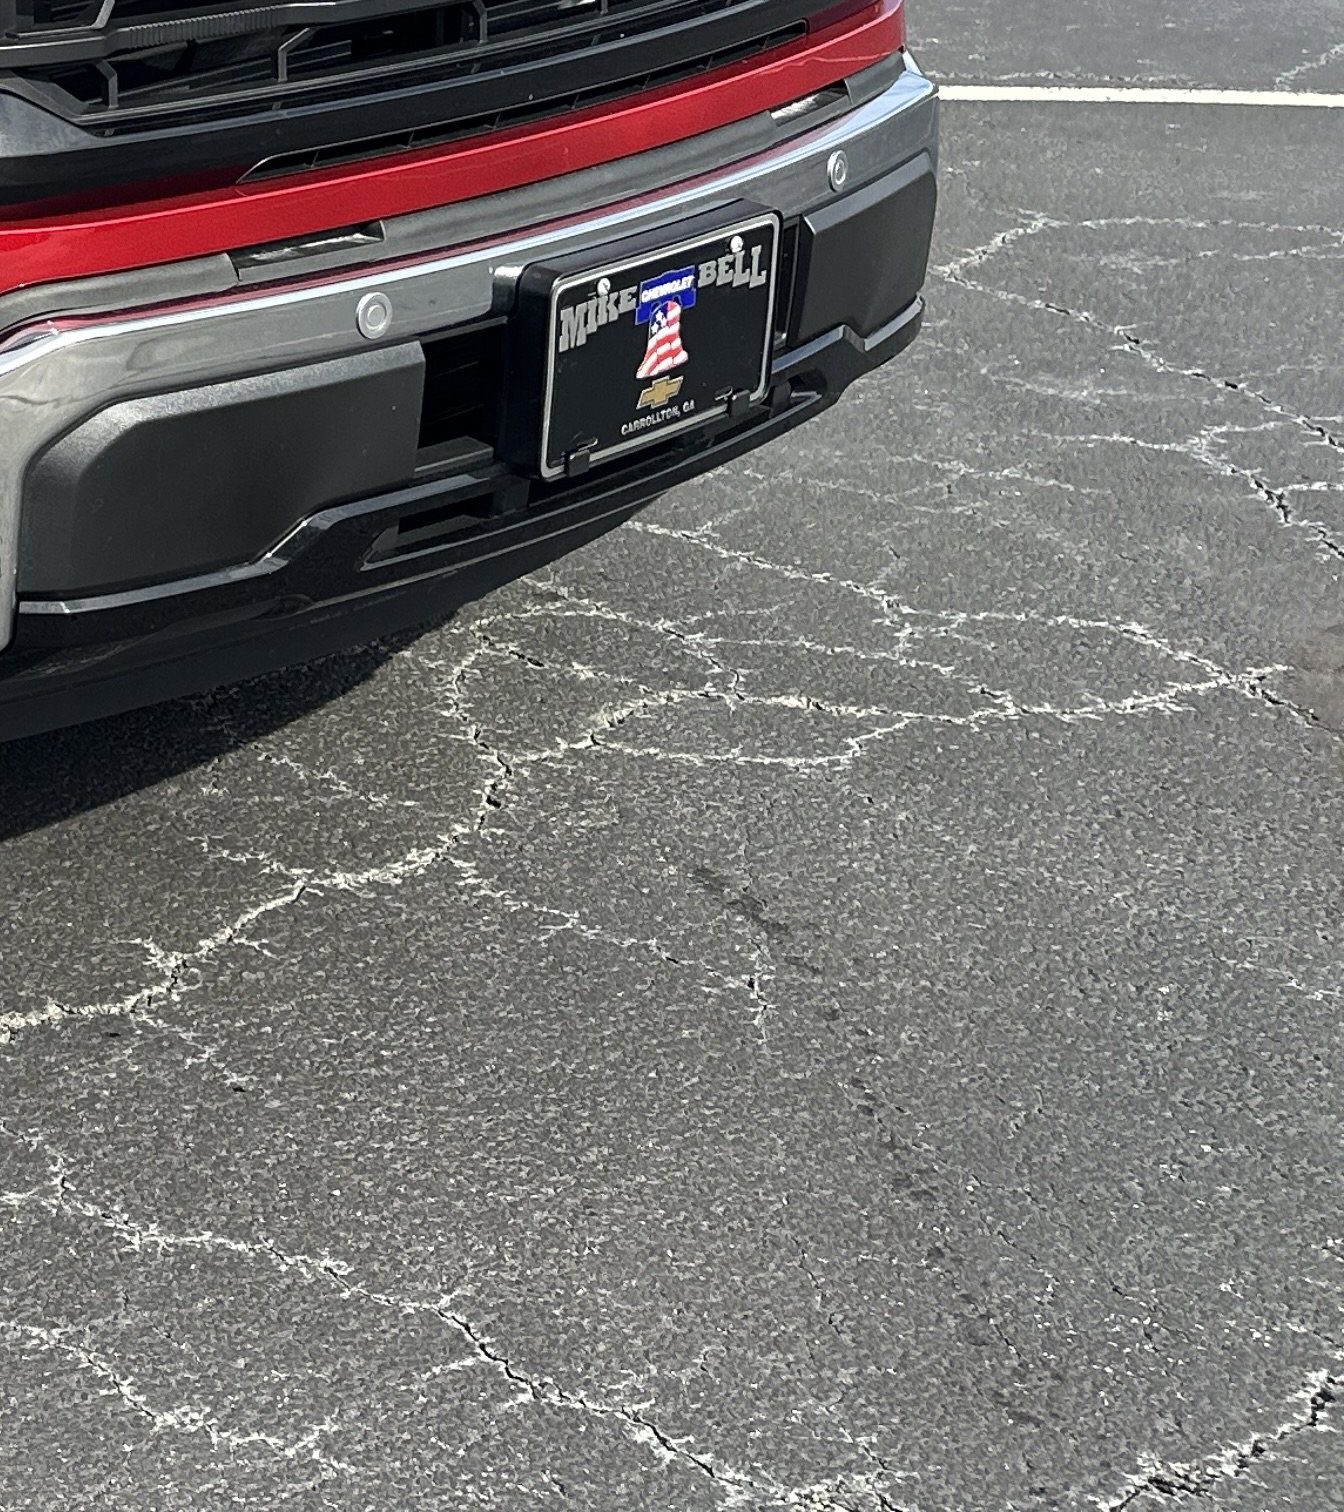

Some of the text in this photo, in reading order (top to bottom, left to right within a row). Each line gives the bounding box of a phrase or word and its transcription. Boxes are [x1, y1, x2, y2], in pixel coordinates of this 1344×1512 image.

[559, 244, 767, 353] MIKE BELL
[641, 274, 696, 304] CHEVROLET
[682, 398, 696, 413] GA
